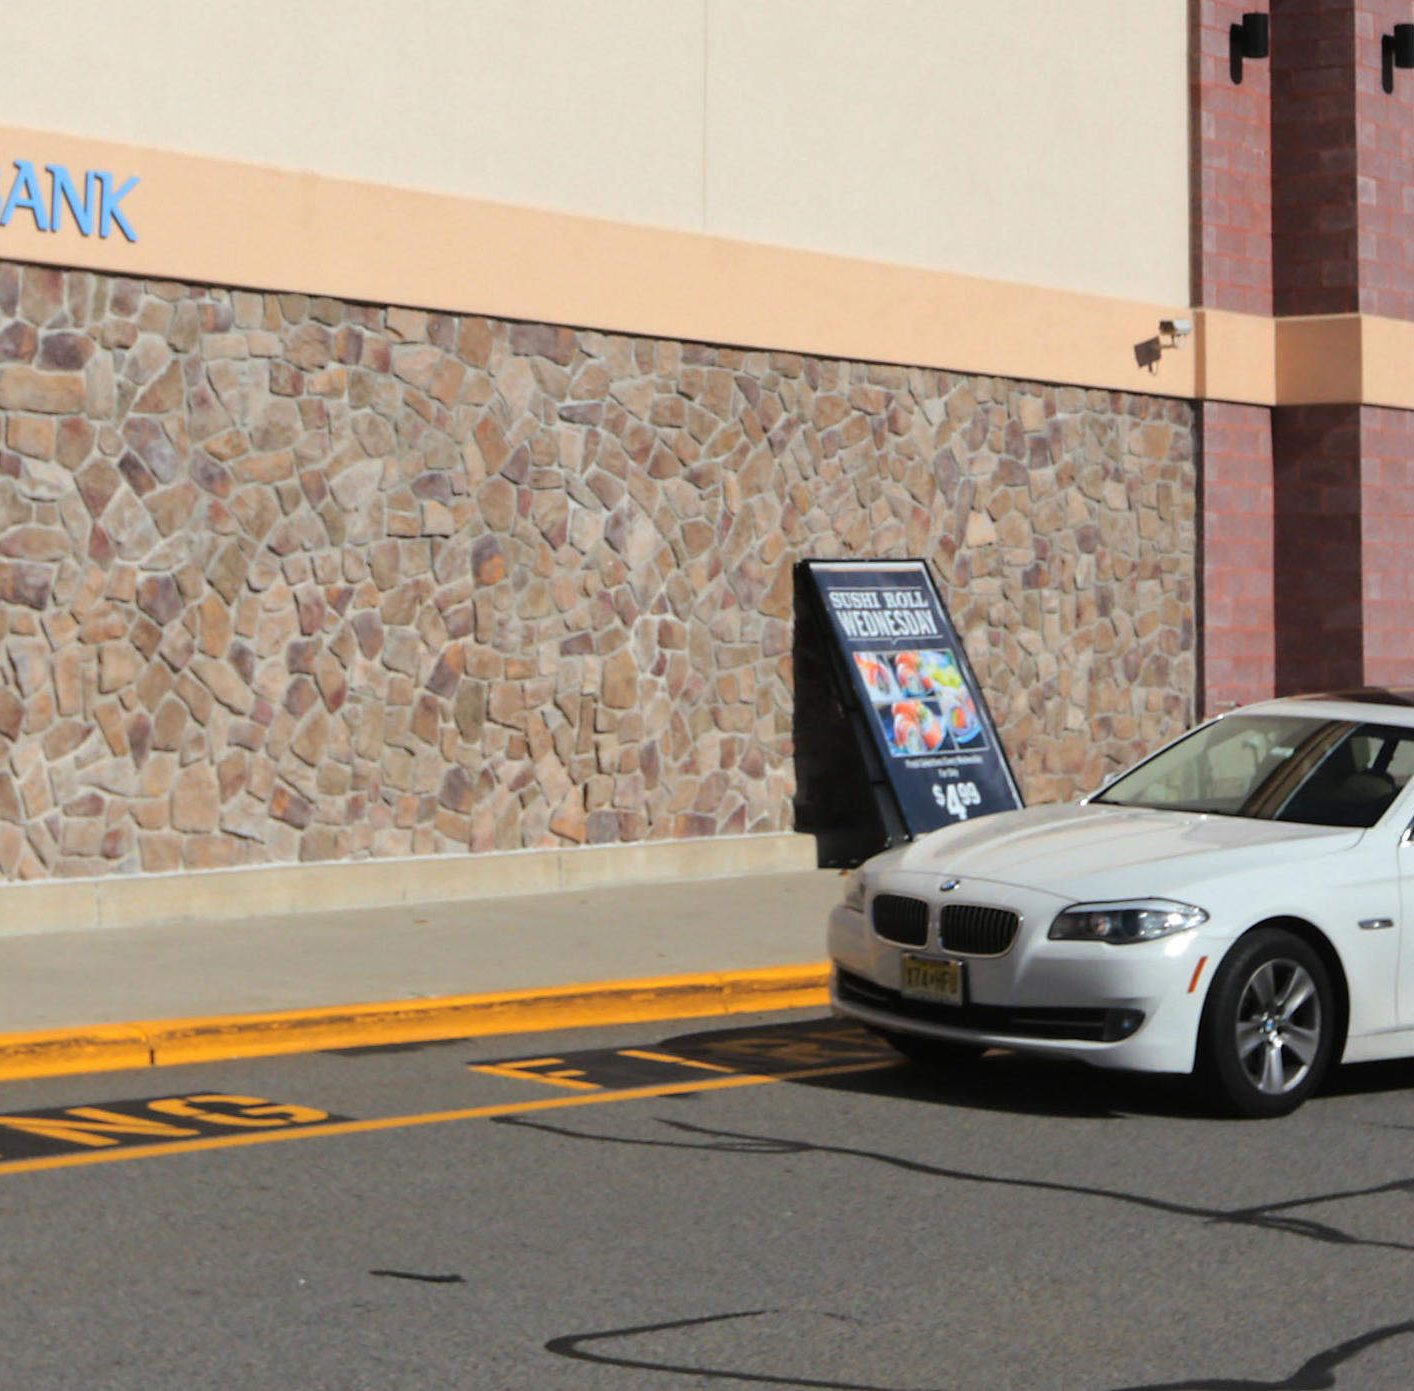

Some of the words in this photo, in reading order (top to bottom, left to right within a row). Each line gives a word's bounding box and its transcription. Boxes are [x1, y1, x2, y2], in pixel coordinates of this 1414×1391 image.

[828, 591, 881, 609] SUSHI
[882, 590, 929, 609] ROLL
[835, 609, 938, 637] WEDNESDAY
